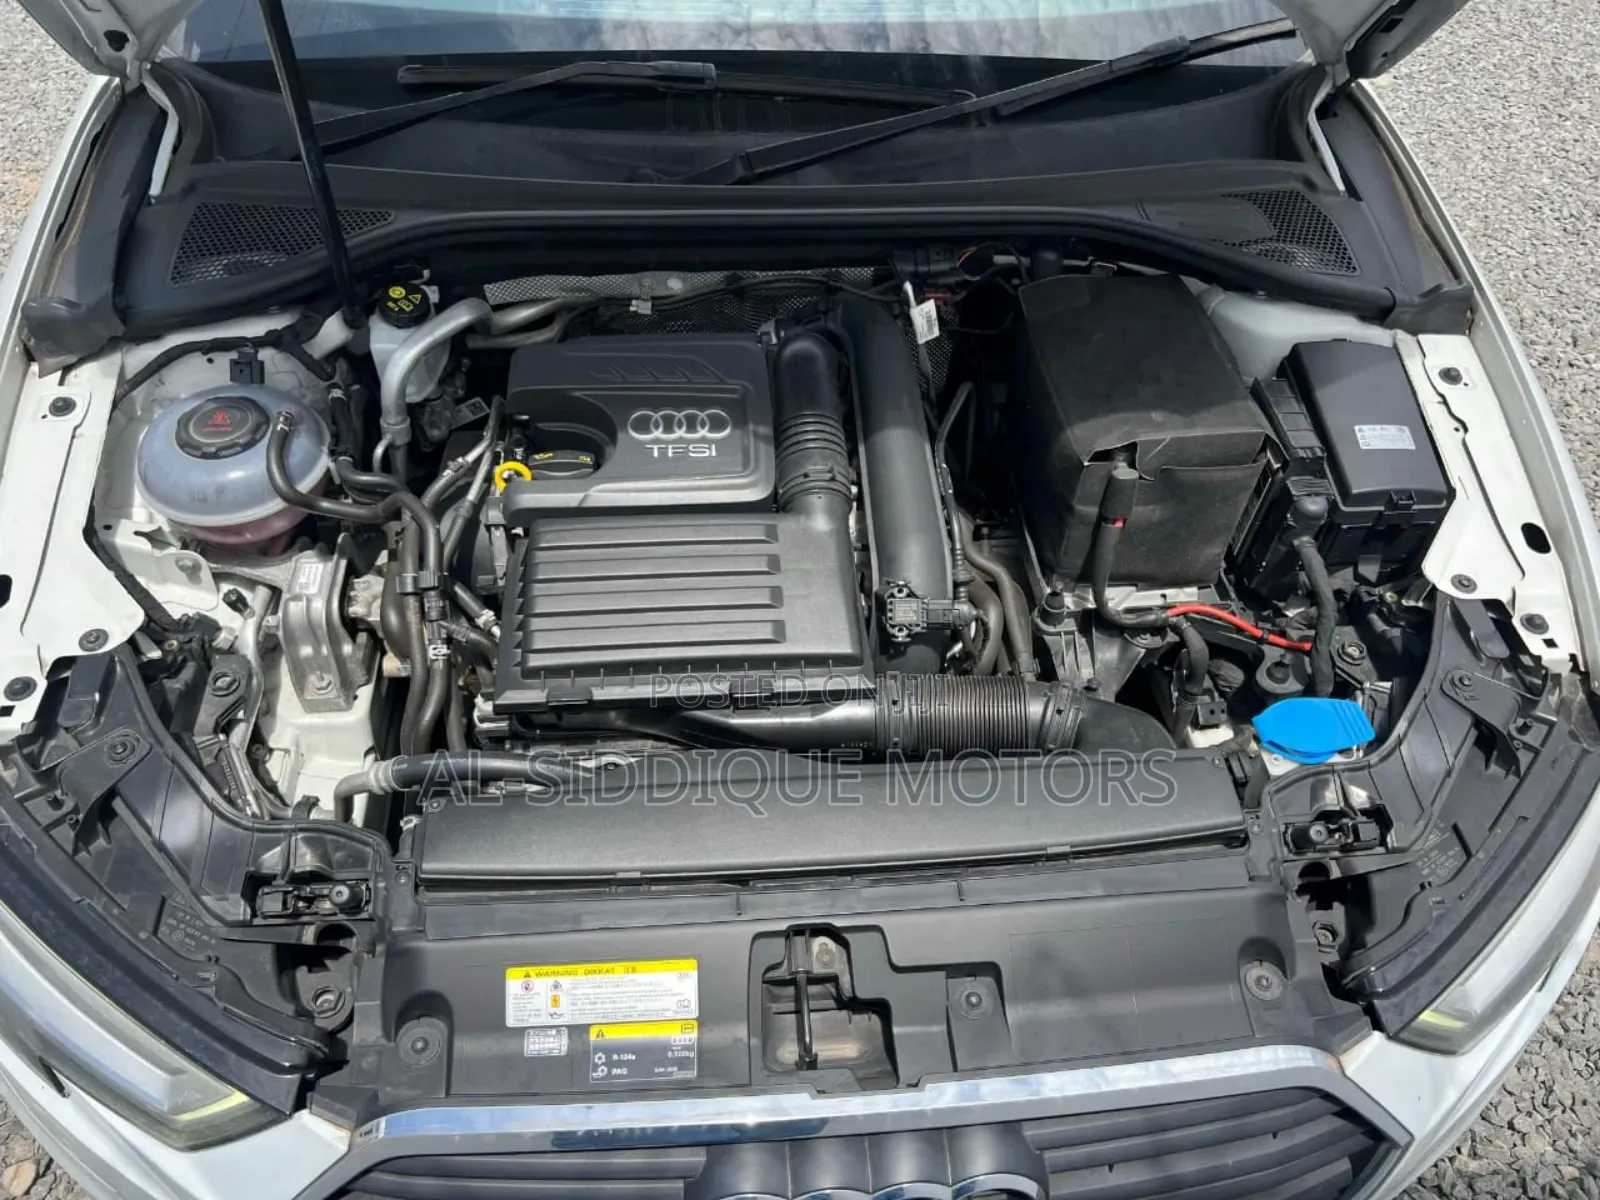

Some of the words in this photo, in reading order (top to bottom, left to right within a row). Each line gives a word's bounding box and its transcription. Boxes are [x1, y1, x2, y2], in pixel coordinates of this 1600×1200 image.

[645, 443, 717, 458] TFSI
[535, 969, 579, 978] WARNING
[611, 1067, 628, 1075] PAG
